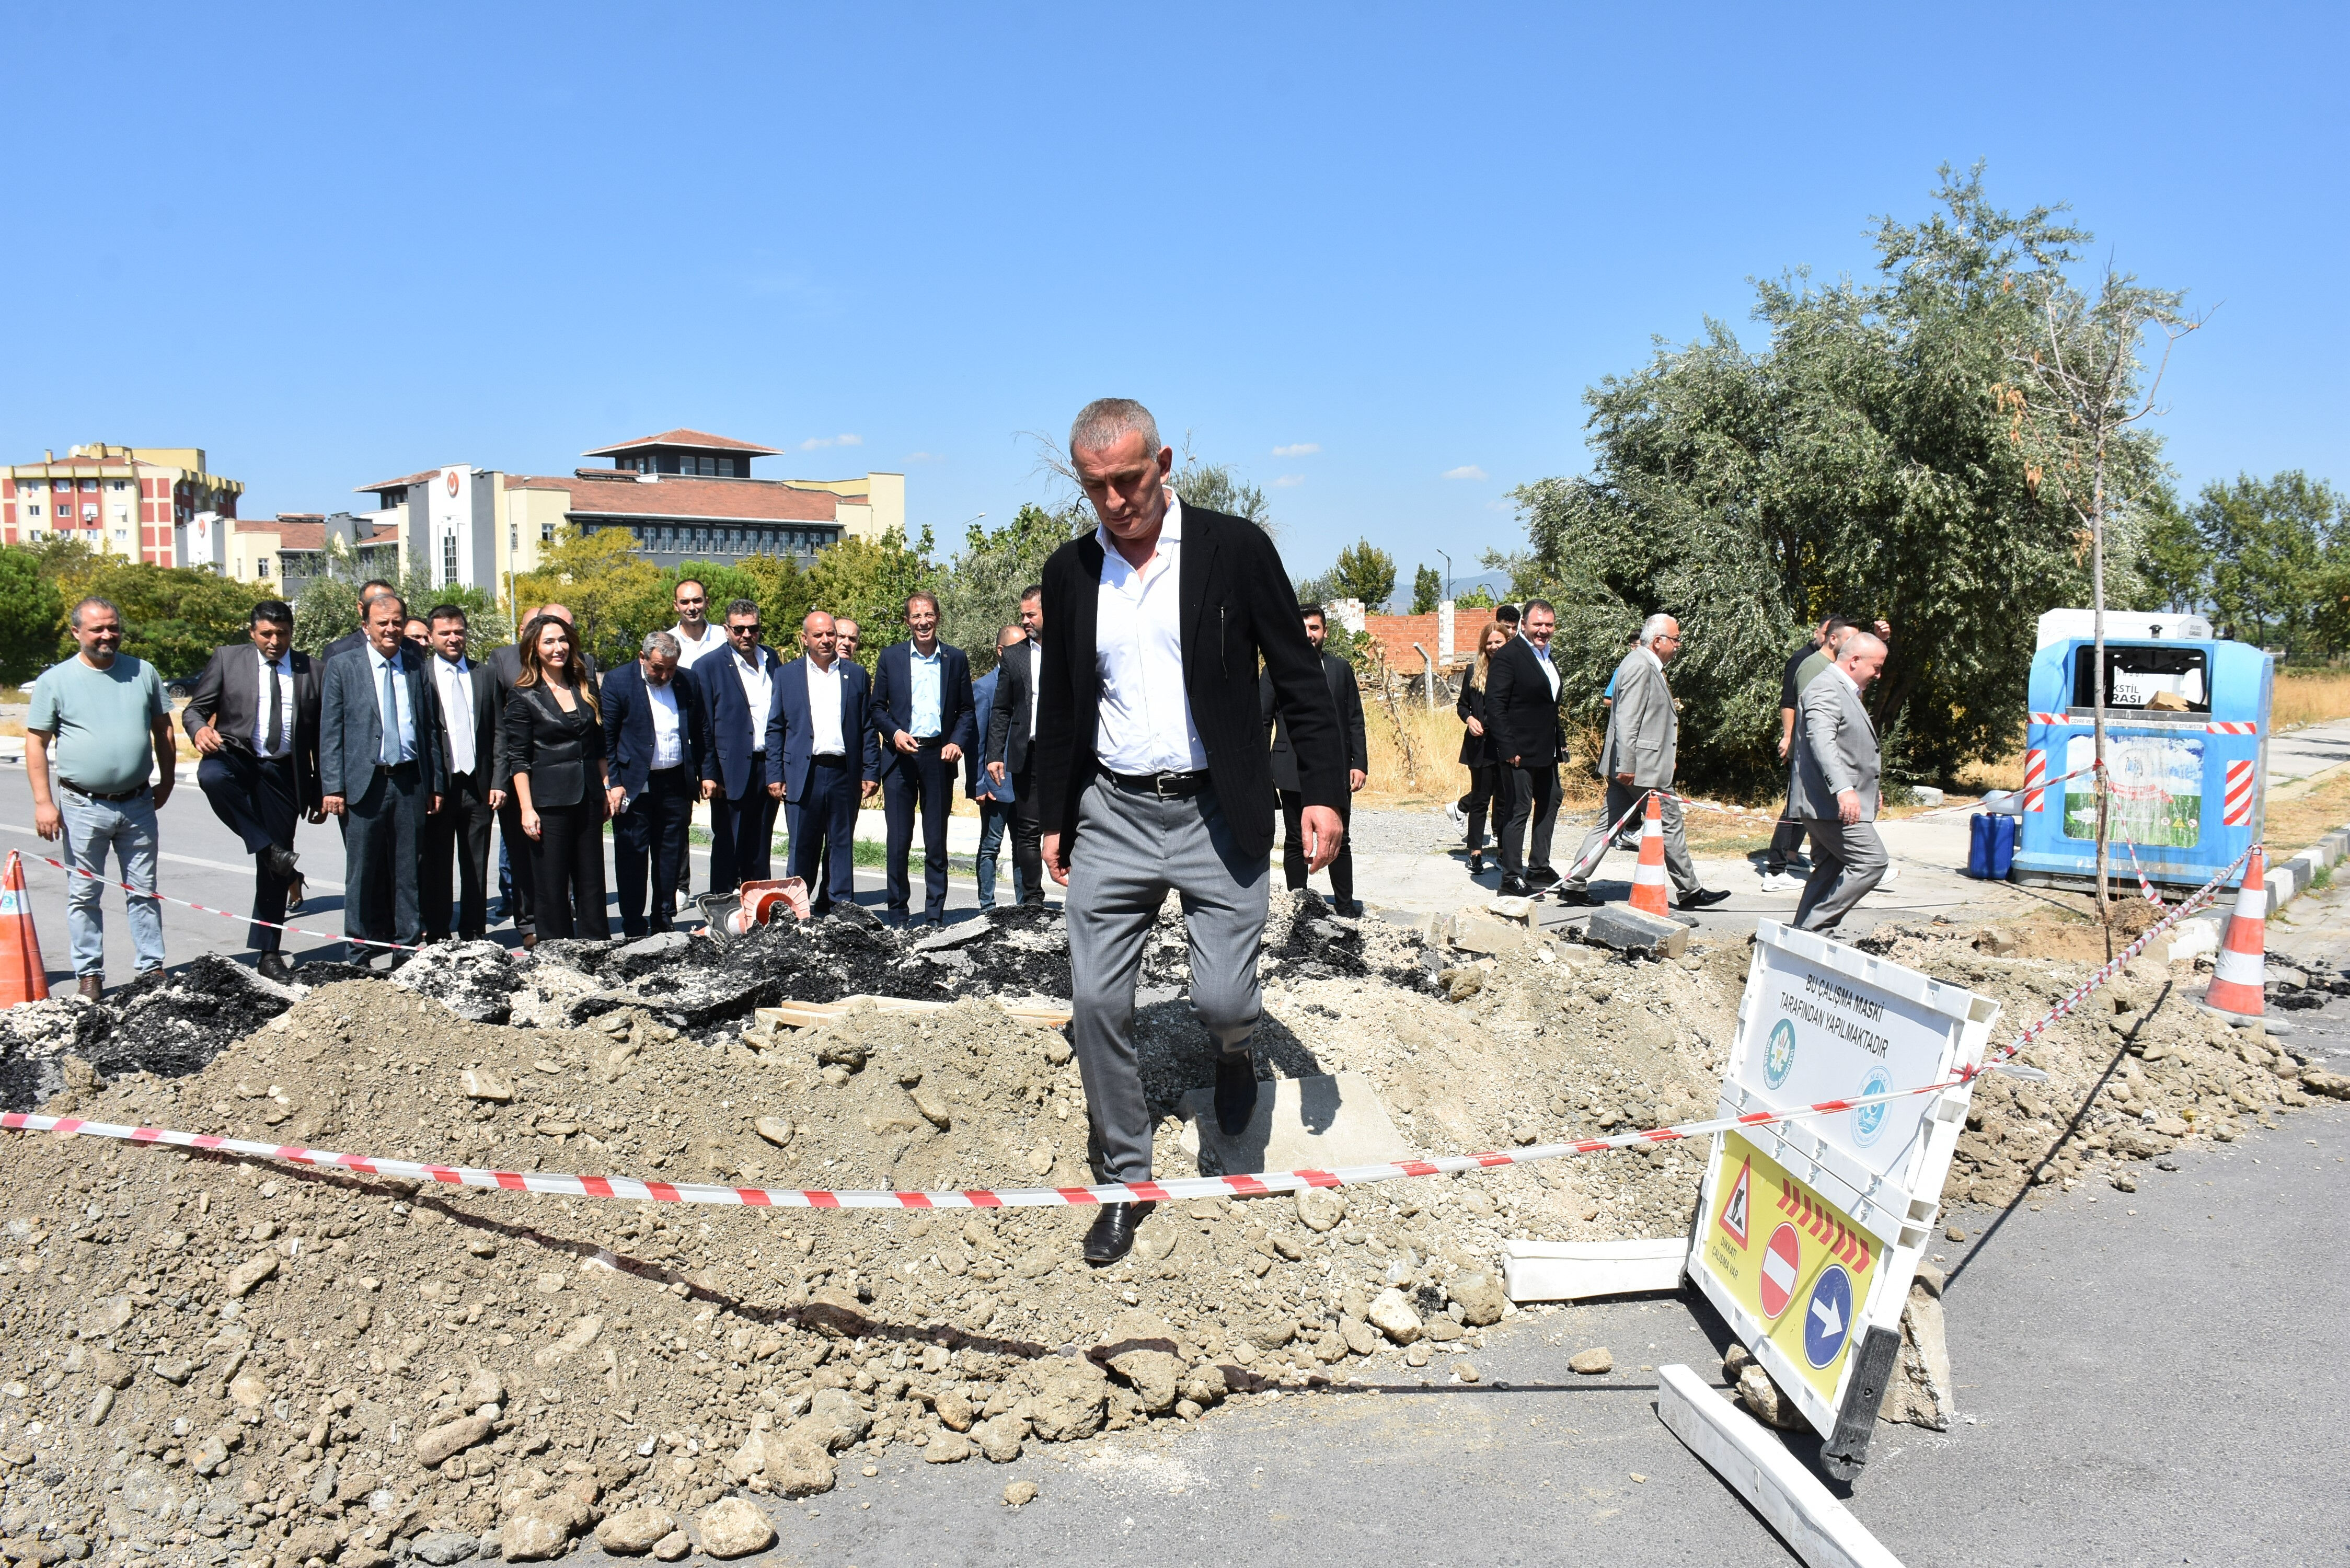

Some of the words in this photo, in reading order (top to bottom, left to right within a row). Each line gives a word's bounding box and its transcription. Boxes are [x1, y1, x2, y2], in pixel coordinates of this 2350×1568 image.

[1806, 974, 1818, 994] BU
[1817, 979, 1853, 1008] ÇALIŞMA
[1853, 995, 1884, 1023] MASKİ
[1780, 991, 1825, 1028] TARAFINDAN
[1825, 1012, 1889, 1059] YAPILMAKTADIR
[1712, 1246, 1729, 1272] ÇALIŞMA
[1729, 1264, 1738, 1281] VAR
[1720, 1236, 1737, 1260] DİKKAT!
